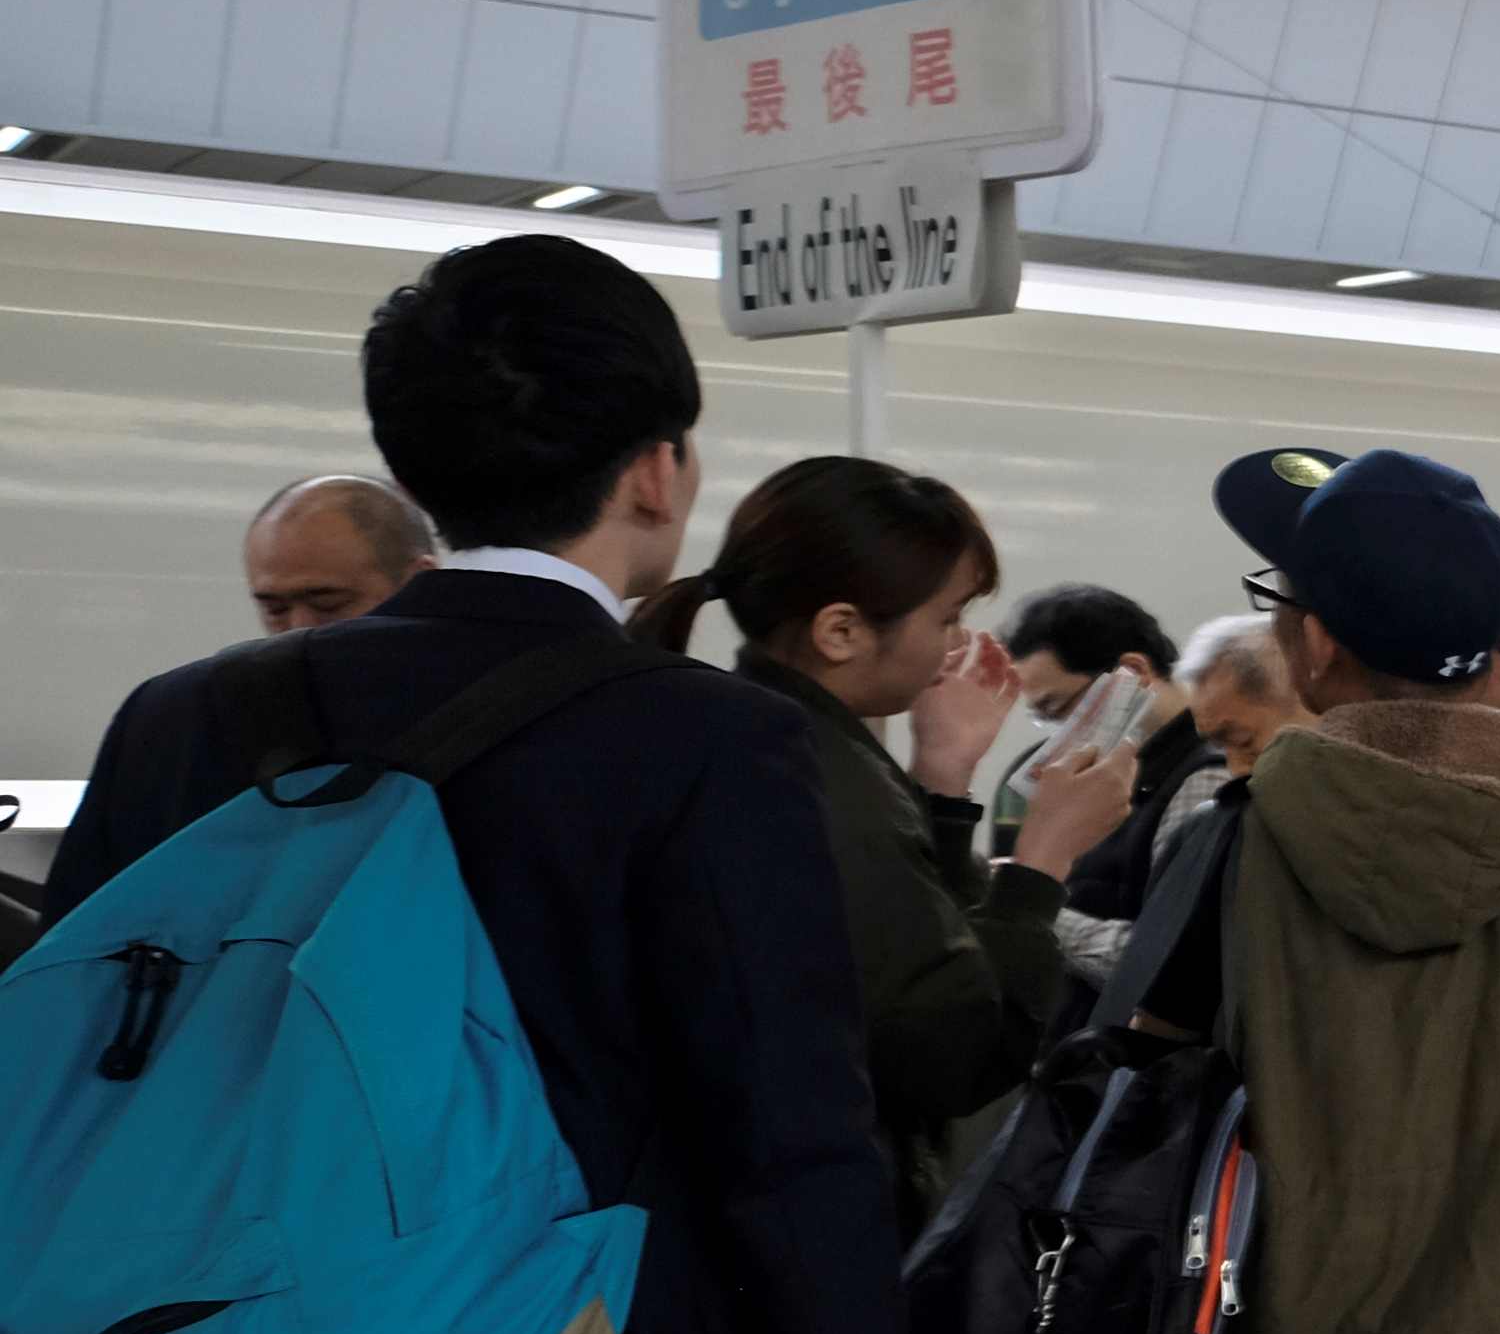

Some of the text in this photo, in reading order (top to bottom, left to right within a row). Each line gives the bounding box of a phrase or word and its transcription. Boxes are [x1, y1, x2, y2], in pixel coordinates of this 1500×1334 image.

[741, 27, 958, 135] 最後尾
[738, 185, 957, 310] End of the line
